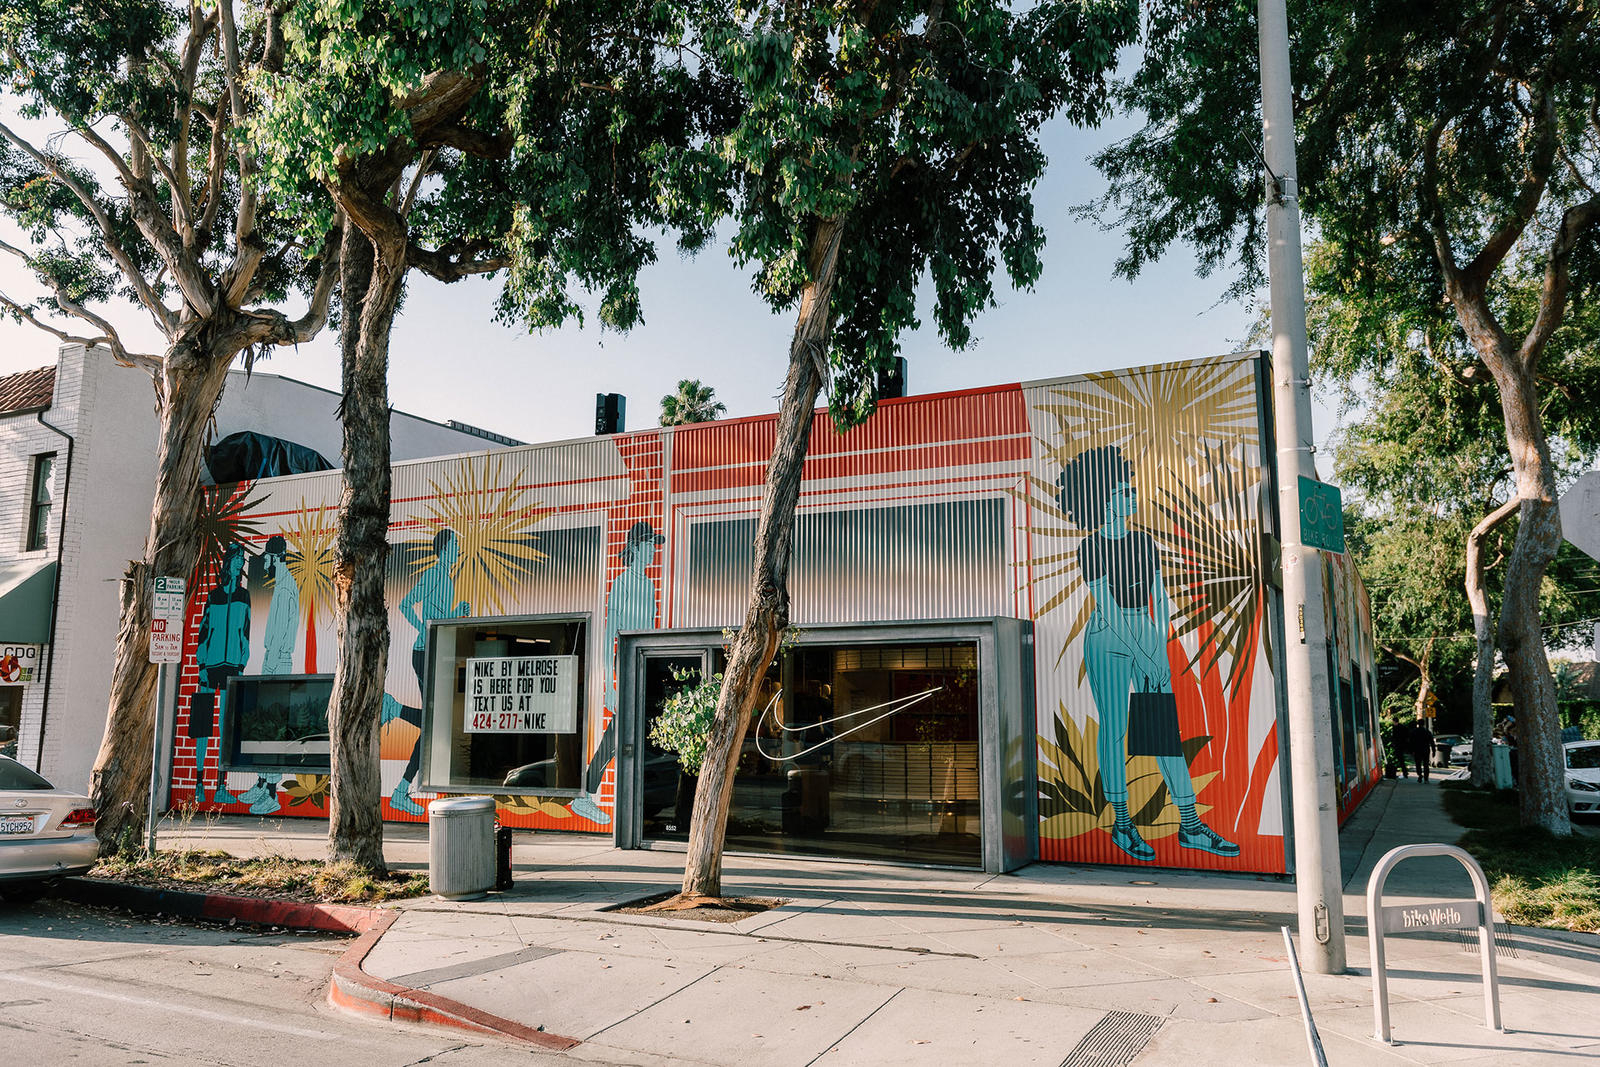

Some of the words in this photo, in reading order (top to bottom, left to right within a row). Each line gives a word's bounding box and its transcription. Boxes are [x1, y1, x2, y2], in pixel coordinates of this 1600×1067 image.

[157, 579, 165, 589] 2
[153, 620, 164, 631] NO
[152, 633, 180, 642] PARKING
[0, 646, 35, 659] CDQ
[474, 661, 494, 677] NIKE
[501, 660, 512, 676] BY
[517, 660, 558, 676] MELROSE
[473, 679, 483, 694] IS
[489, 678, 512, 694] HERE
[517, 678, 534, 694] FOR
[540, 678, 556, 693] YOU
[473, 696, 496, 711] TEXT
[501, 696, 513, 711] US
[518, 696, 531, 711] AT
[0, 822, 33, 832] 5YCH952
